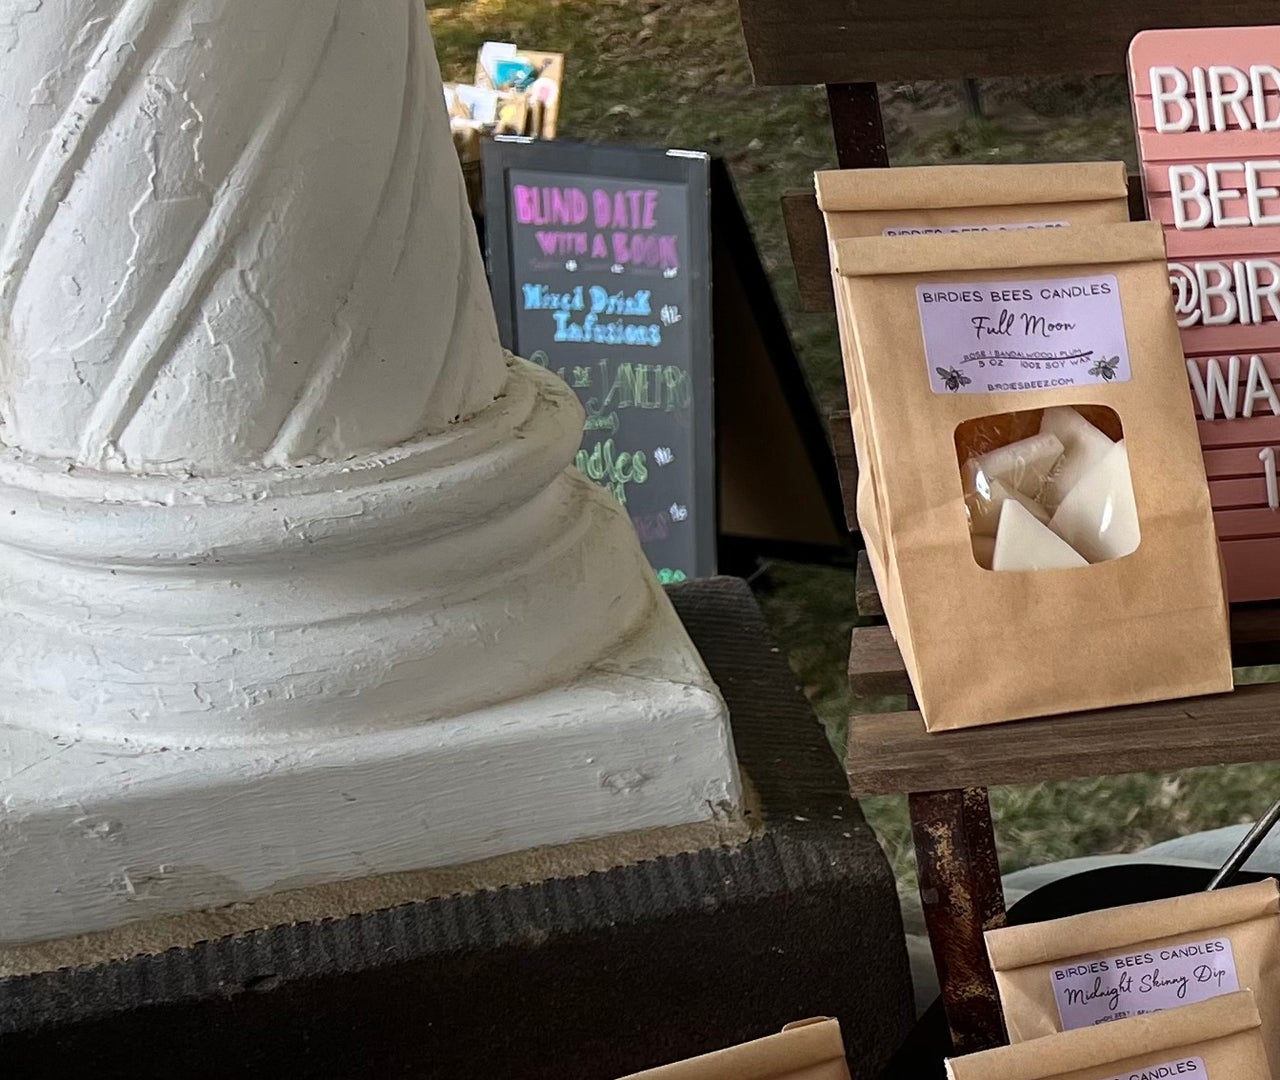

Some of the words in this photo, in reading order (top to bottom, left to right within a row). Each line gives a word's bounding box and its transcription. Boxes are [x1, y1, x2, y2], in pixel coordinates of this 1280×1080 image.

[513, 184, 588, 225] BLIND
[592, 188, 659, 230] DATE
[535, 232, 587, 257] WITH
[591, 234, 607, 259] A
[613, 232, 679, 268] BOOK
[923, 291, 983, 303] BIRDIES
[990, 289, 1033, 302] BEES
[1040, 283, 1111, 299] CANDLES
[971, 309, 1014, 340] Full
[1021, 314, 1076, 337] Moon
[1055, 962, 1109, 980] BIRDIES
[1115, 953, 1153, 968] BEES
[1160, 941, 1225, 961] CANDLES
[1064, 973, 1133, 1010] Midnight
[1139, 969, 1188, 998] Skinny
[1194, 965, 1226, 986] Dip
